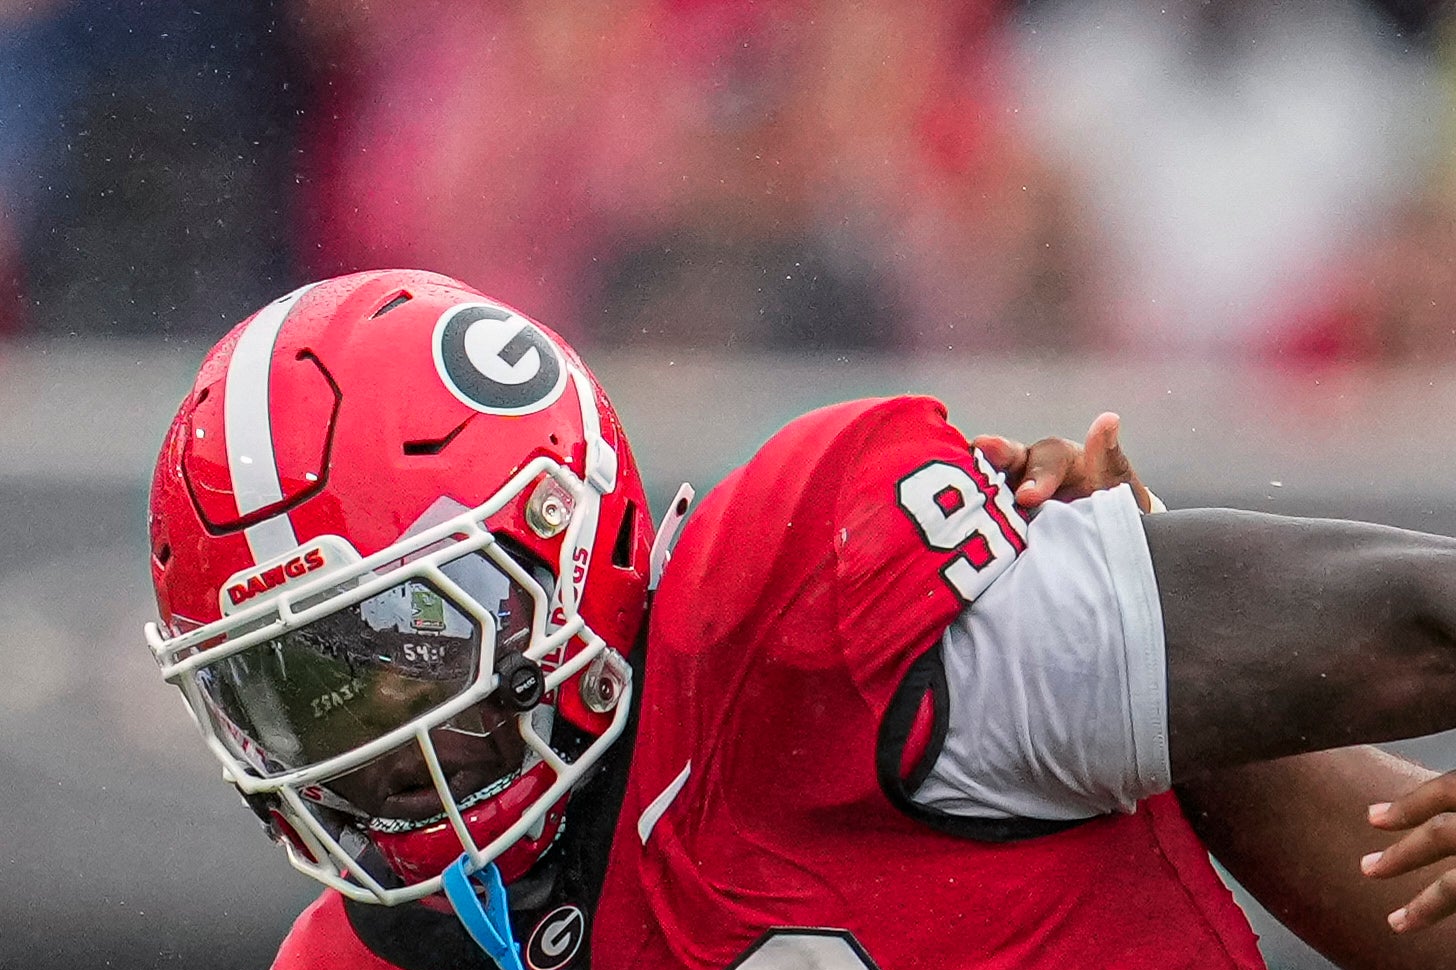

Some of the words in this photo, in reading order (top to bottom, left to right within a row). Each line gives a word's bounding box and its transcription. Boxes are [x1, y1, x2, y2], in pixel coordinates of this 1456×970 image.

[441, 306, 561, 409] G
[227, 548, 325, 606] DAWGS
[528, 907, 583, 970] G
